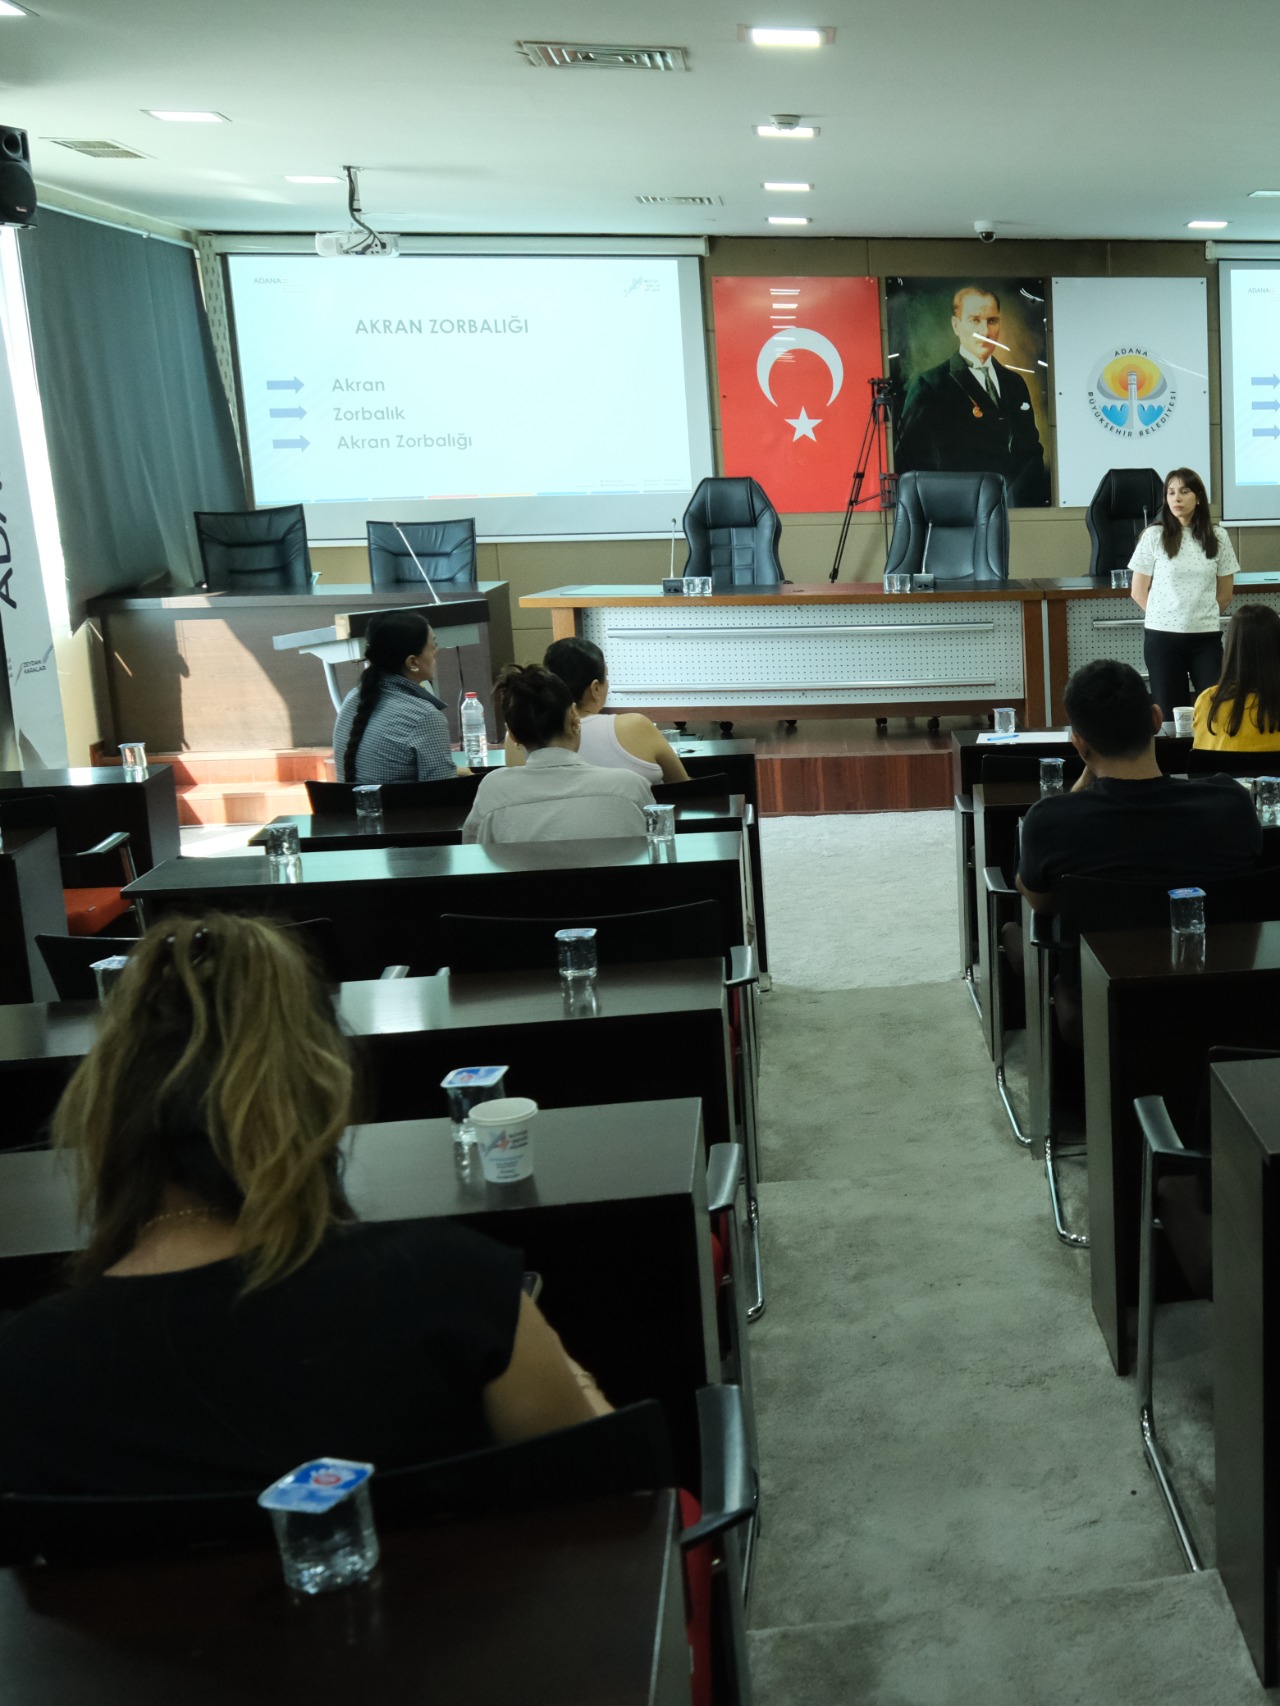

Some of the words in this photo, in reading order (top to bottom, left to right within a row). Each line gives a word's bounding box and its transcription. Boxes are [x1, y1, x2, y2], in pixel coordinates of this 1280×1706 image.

[355, 319, 423, 335] AKRAN
[428, 315, 529, 334] ZORBALIĞI
[1114, 348, 1148, 357] ADANA
[331, 377, 385, 393] Akran
[332, 406, 406, 422] Zorbalık
[337, 435, 391, 450] Akran
[395, 432, 473, 451] Zorbalığı
